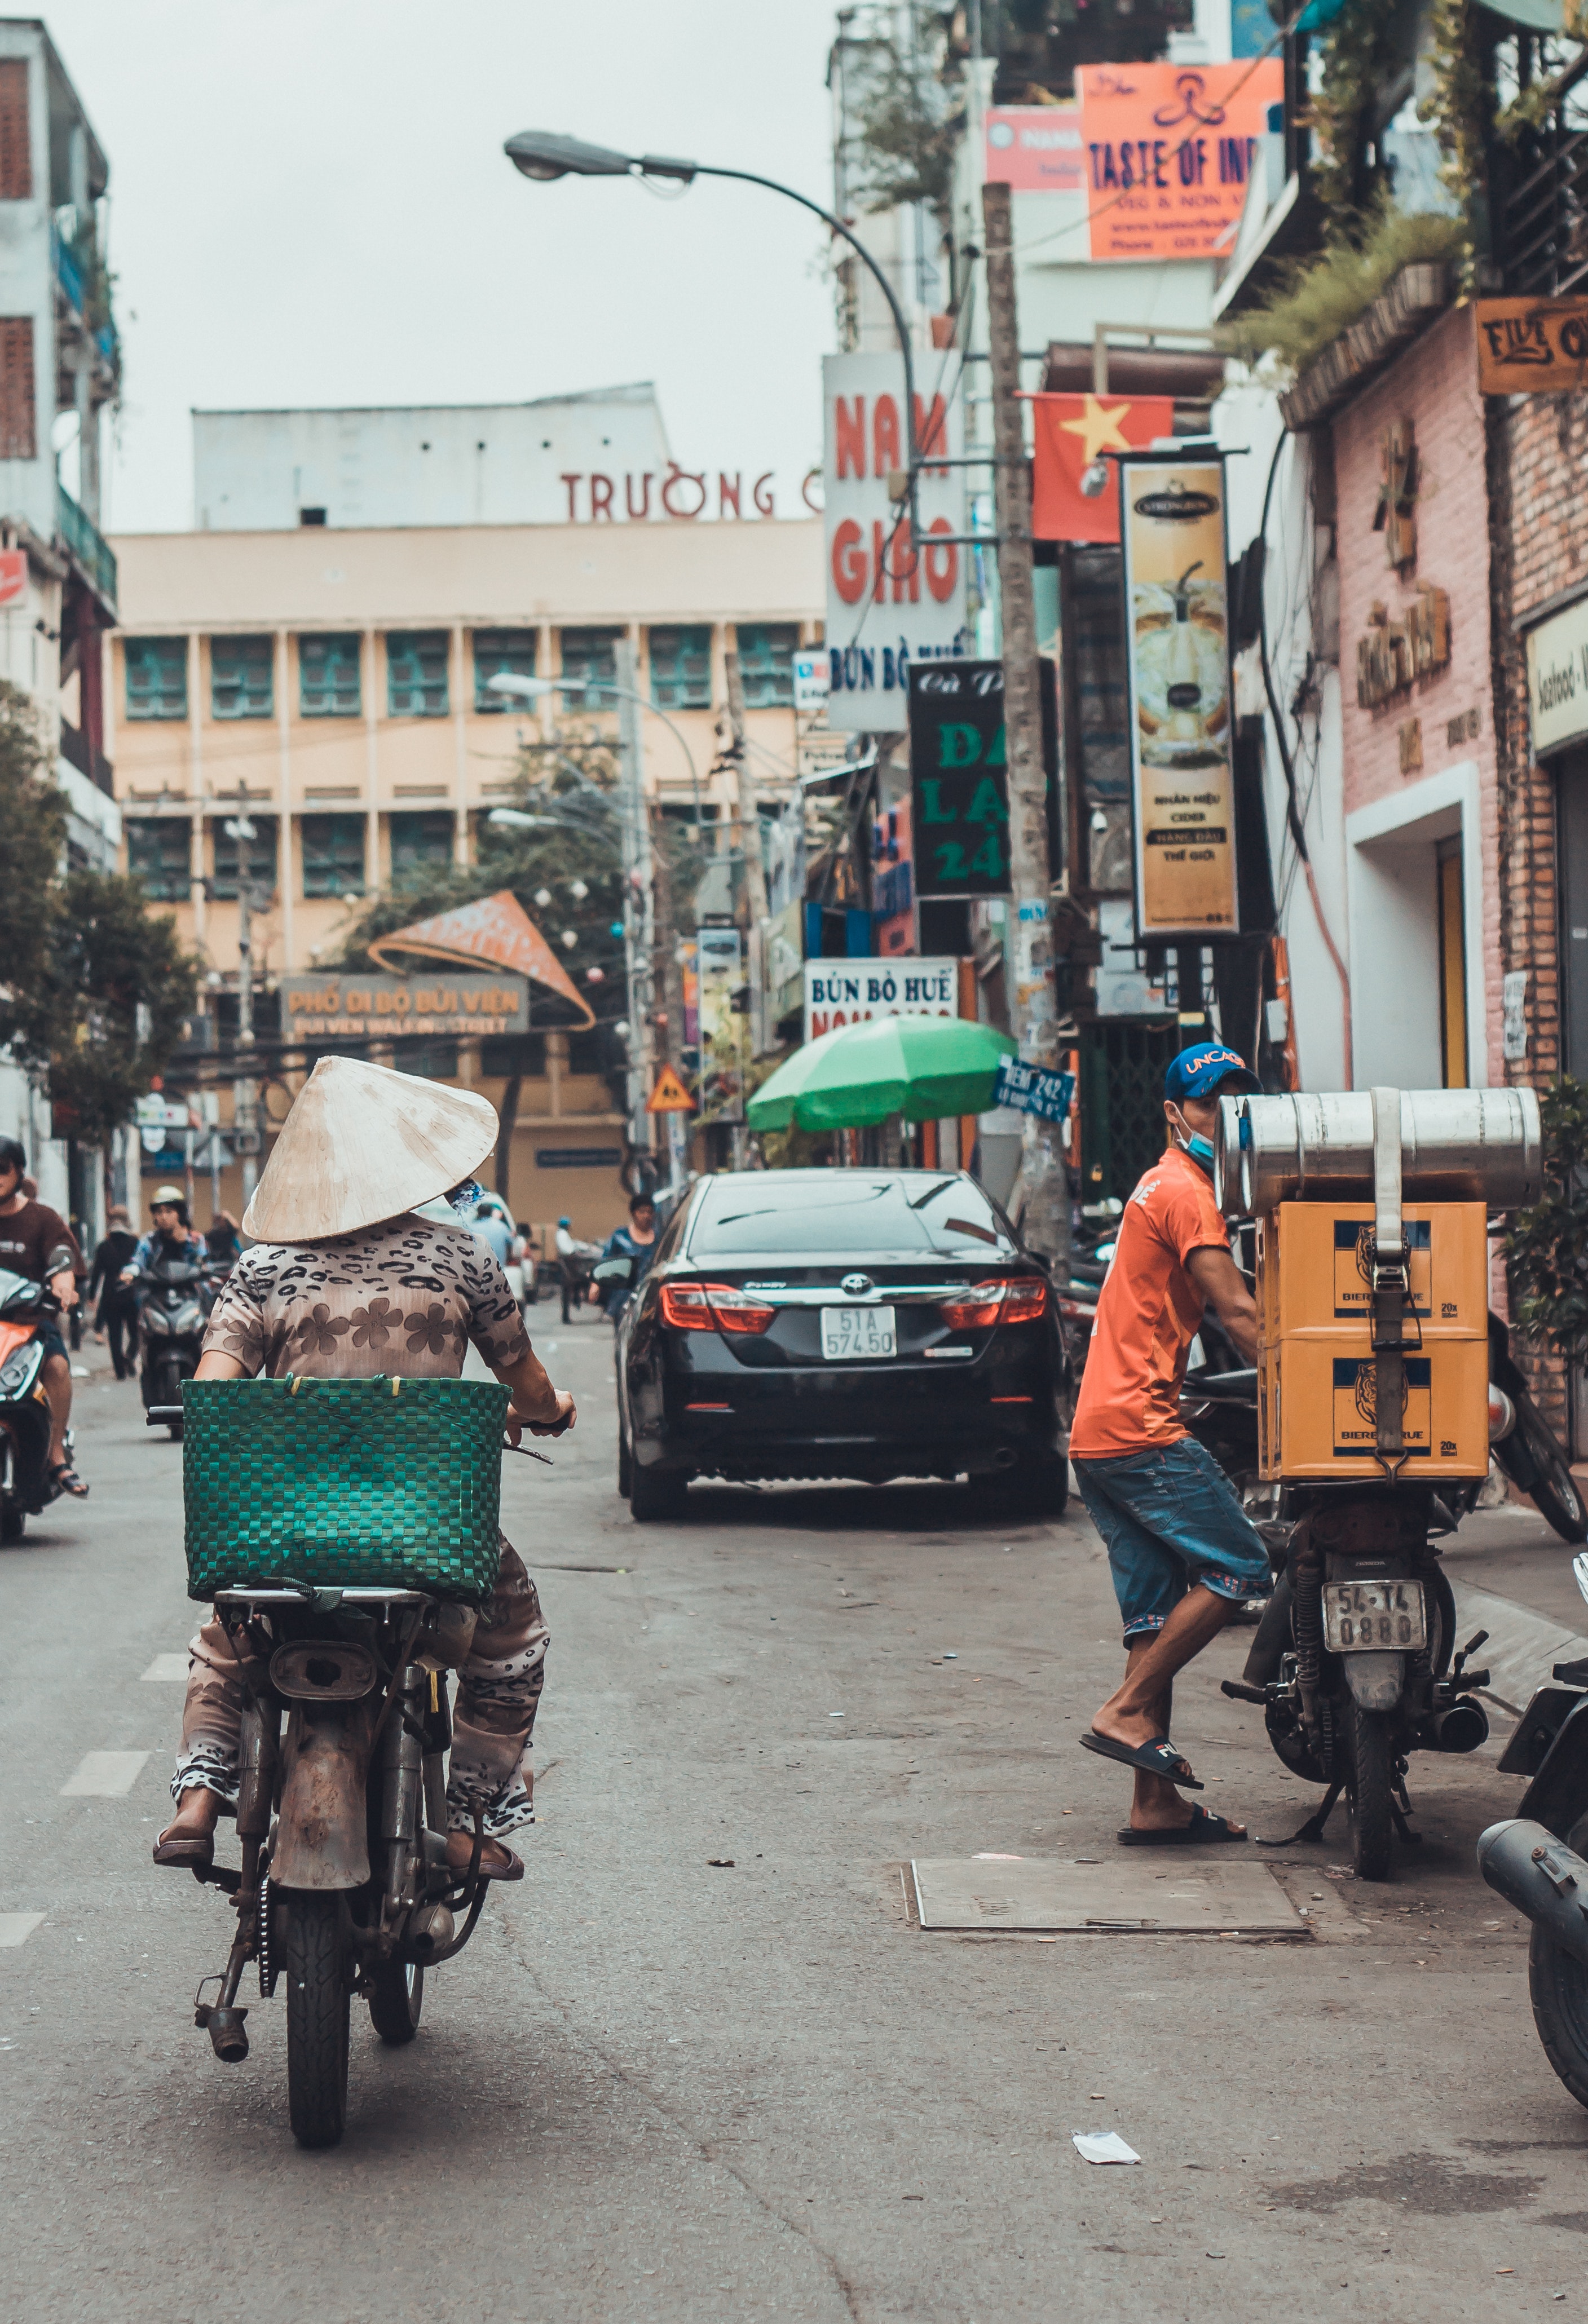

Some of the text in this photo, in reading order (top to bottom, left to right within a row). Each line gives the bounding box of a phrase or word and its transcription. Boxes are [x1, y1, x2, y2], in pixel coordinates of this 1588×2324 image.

[1089, 140, 1169, 190] TASTE
[1177, 138, 1207, 187] OF
[1560, 316, 1588, 360] O
[834, 391, 949, 480] NAM
[831, 516, 959, 604] GIAO
[812, 967, 952, 1003] BÚN BÒ HUẾ
[1342, 1292, 1373, 1301] BIER
[840, 1310, 877, 1332] 51A
[1401, 1431, 1423, 1439] RUE
